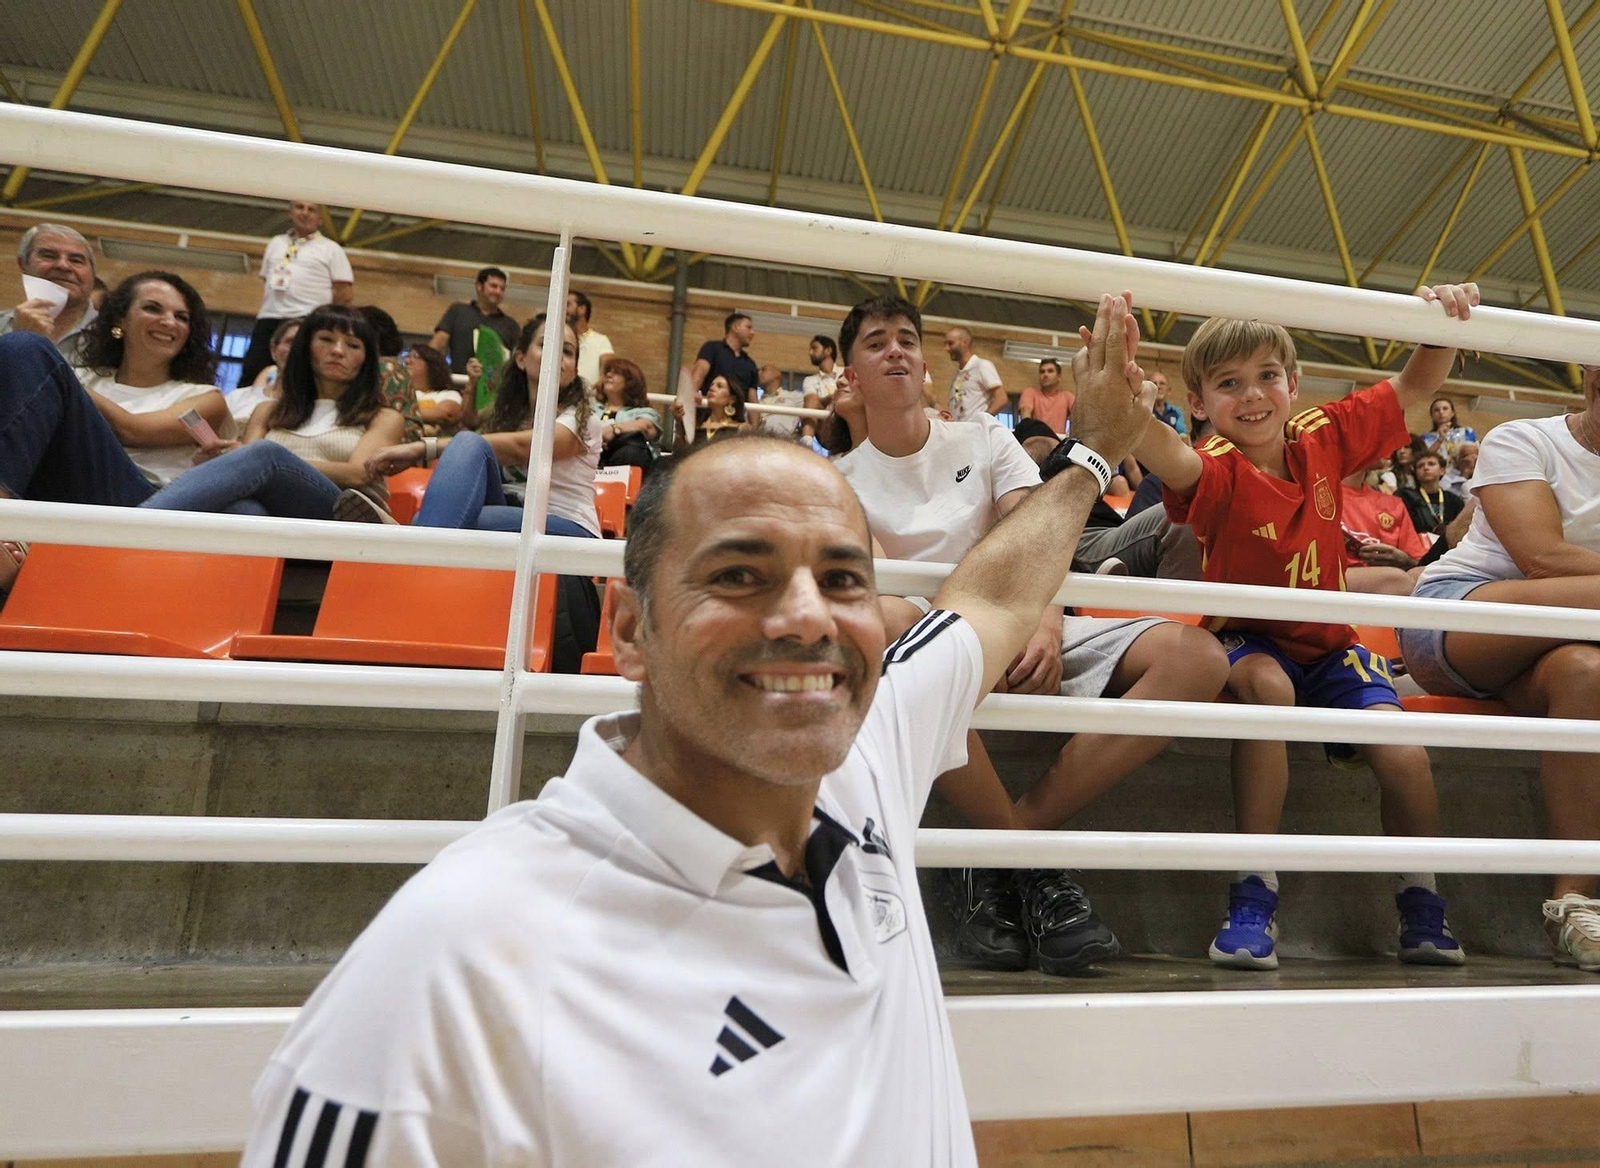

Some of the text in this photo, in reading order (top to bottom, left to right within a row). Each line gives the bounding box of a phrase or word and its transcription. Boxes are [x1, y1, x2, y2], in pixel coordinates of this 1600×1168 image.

[956, 464, 970, 477] NIKE
[1284, 539, 1321, 588] 14
[1343, 649, 1394, 685] 14
